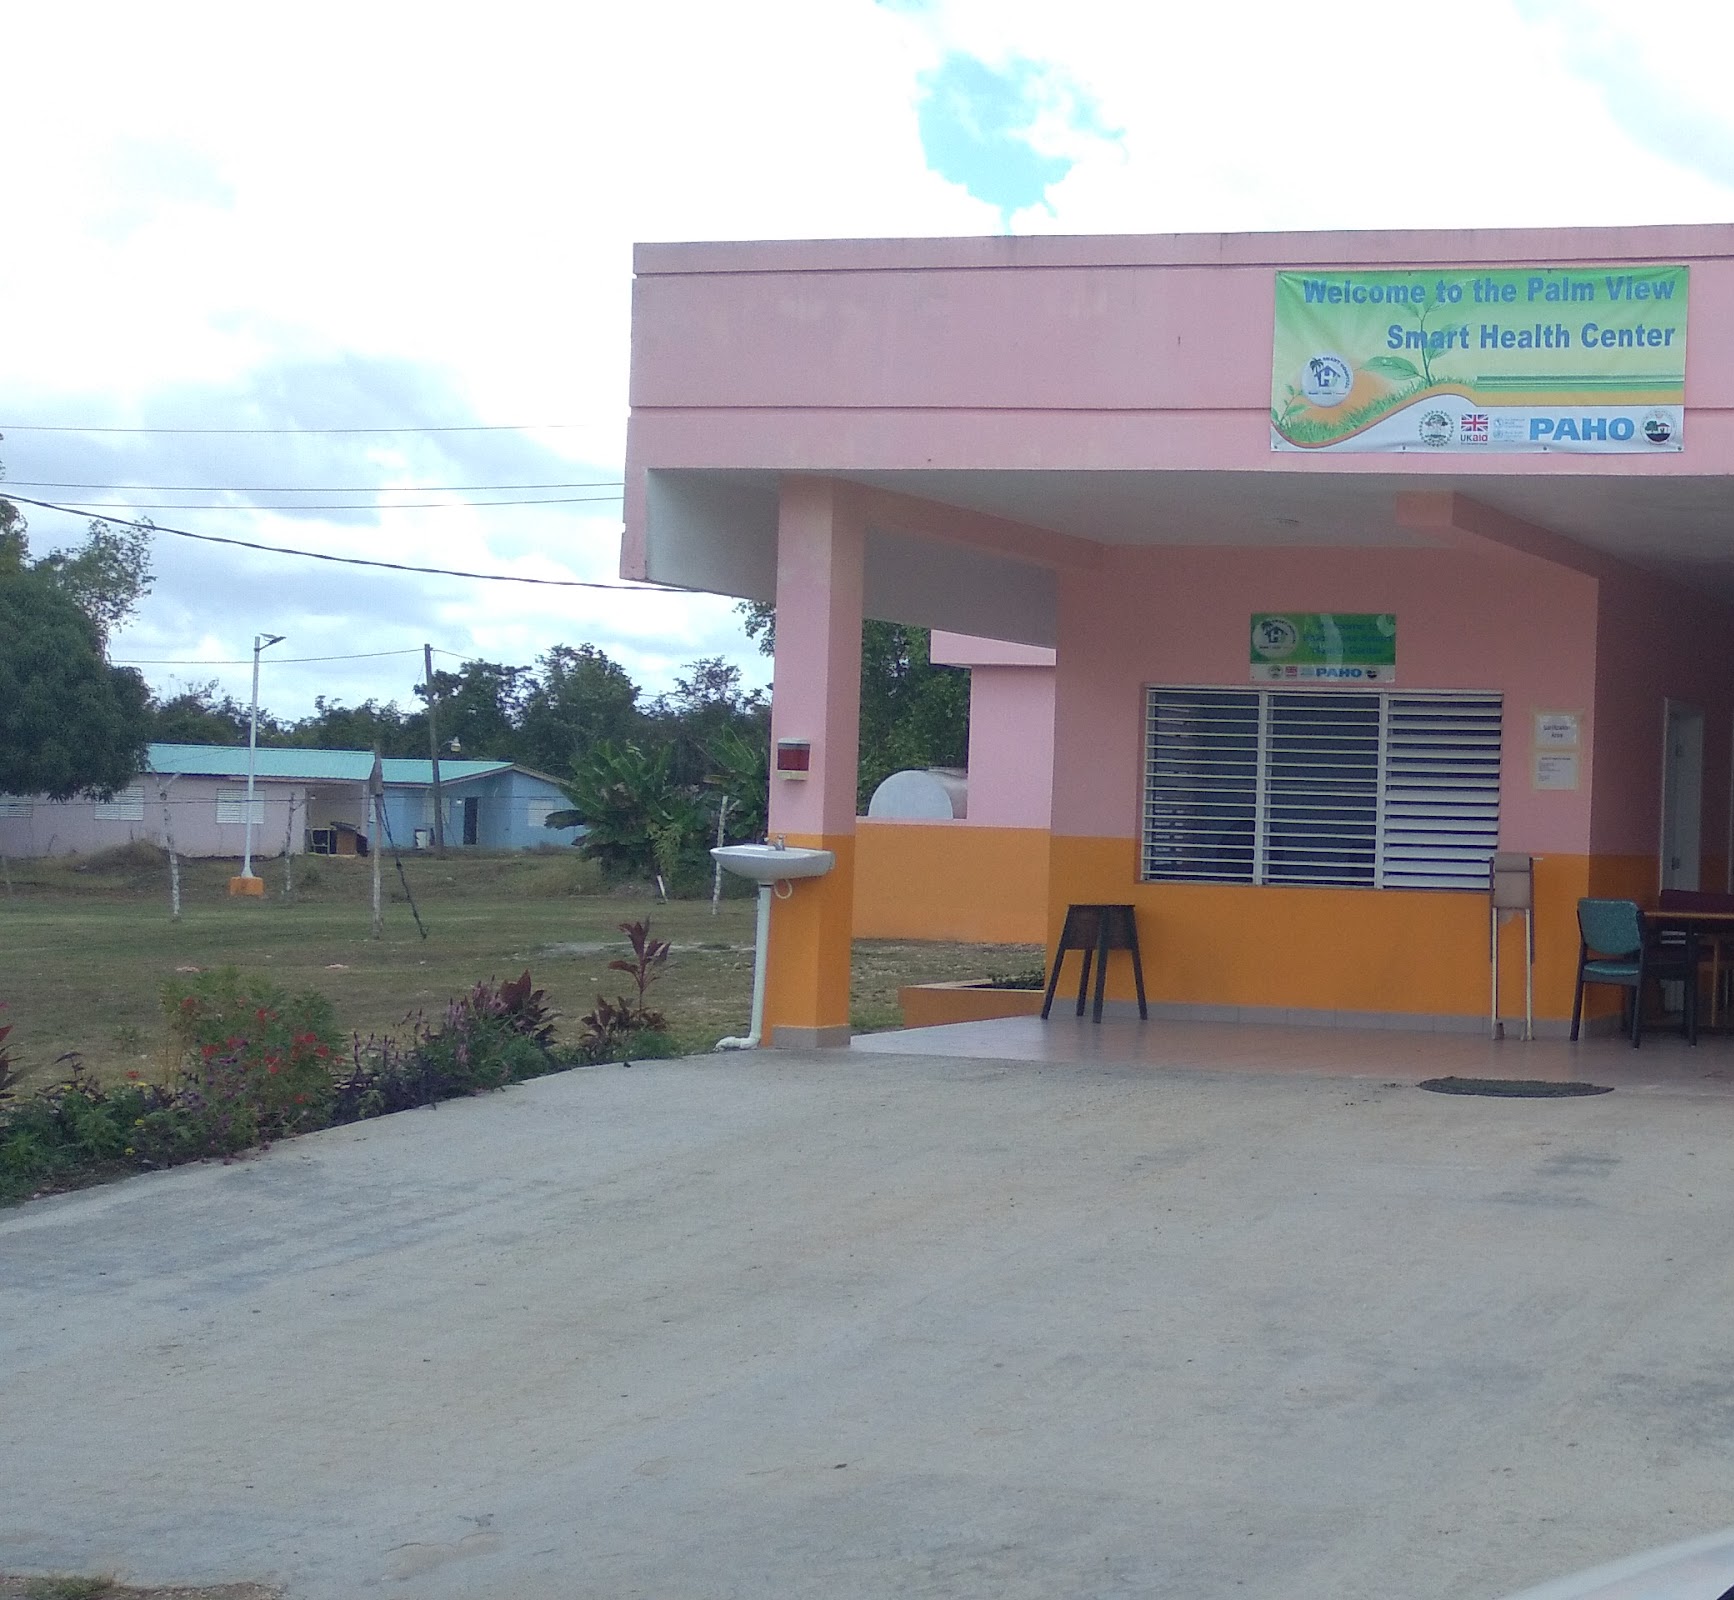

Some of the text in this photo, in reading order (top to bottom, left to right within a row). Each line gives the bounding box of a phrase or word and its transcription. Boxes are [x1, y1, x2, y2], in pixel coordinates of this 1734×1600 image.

[1303, 275, 1676, 304] Welcome to the Palm View
[1387, 322, 1676, 350] Smart Health Center
[1529, 417, 1635, 441] PAHO
[1316, 668, 1362, 678] PAHO
